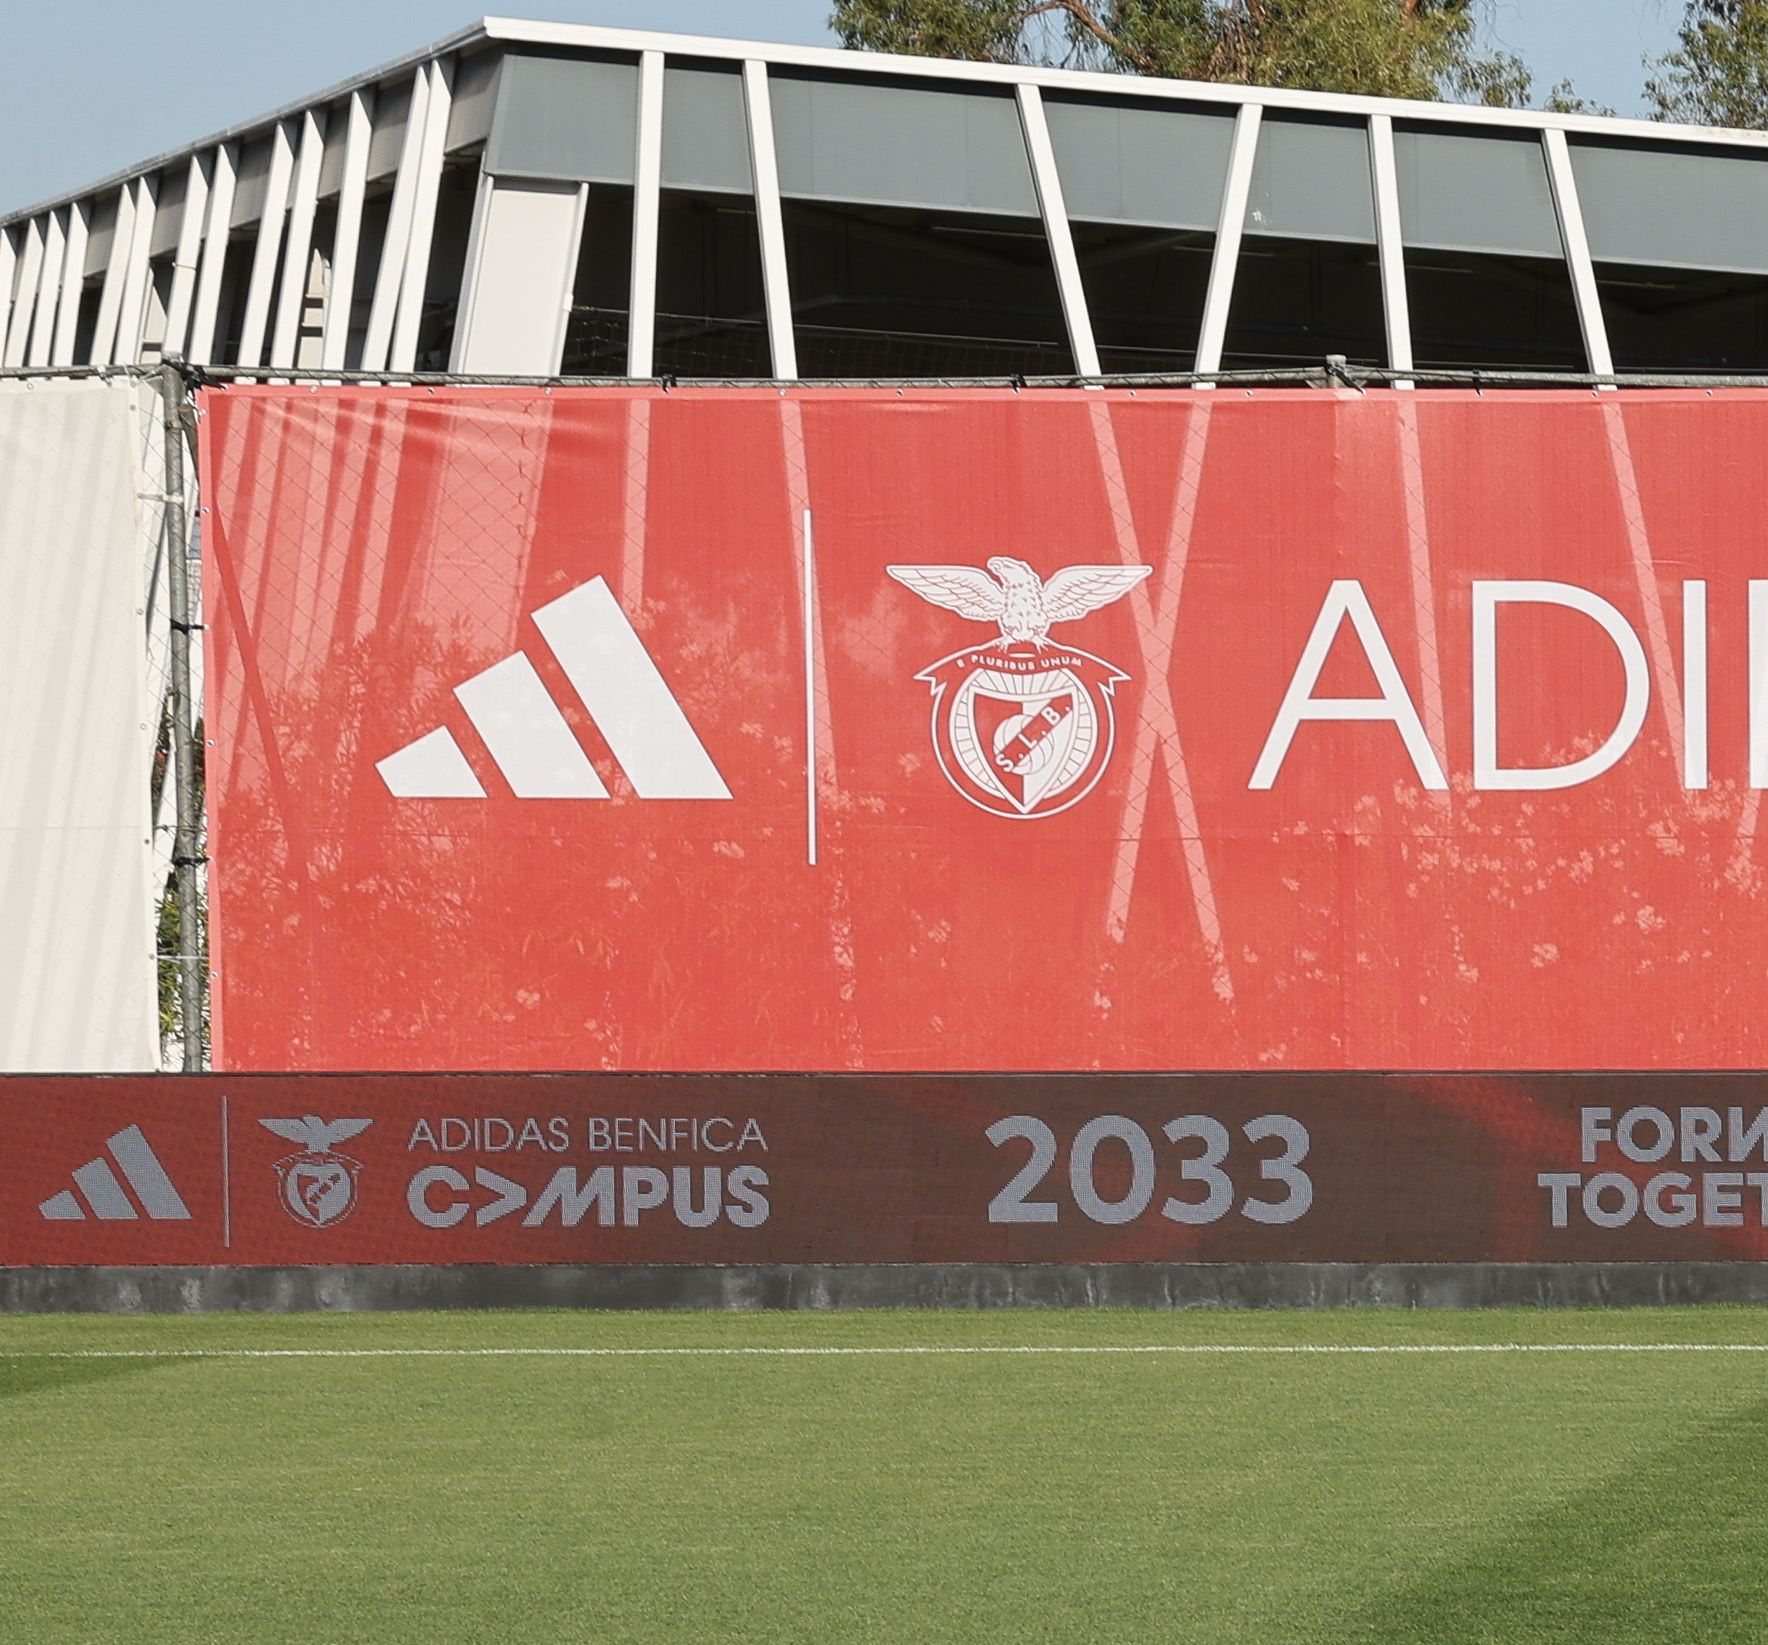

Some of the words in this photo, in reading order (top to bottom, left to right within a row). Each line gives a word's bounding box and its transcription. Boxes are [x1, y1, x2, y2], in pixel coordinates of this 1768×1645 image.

[406, 1117, 571, 1153] ADIDAS
[588, 1116, 769, 1153] BENFICA
[984, 1114, 1313, 1225] 2033
